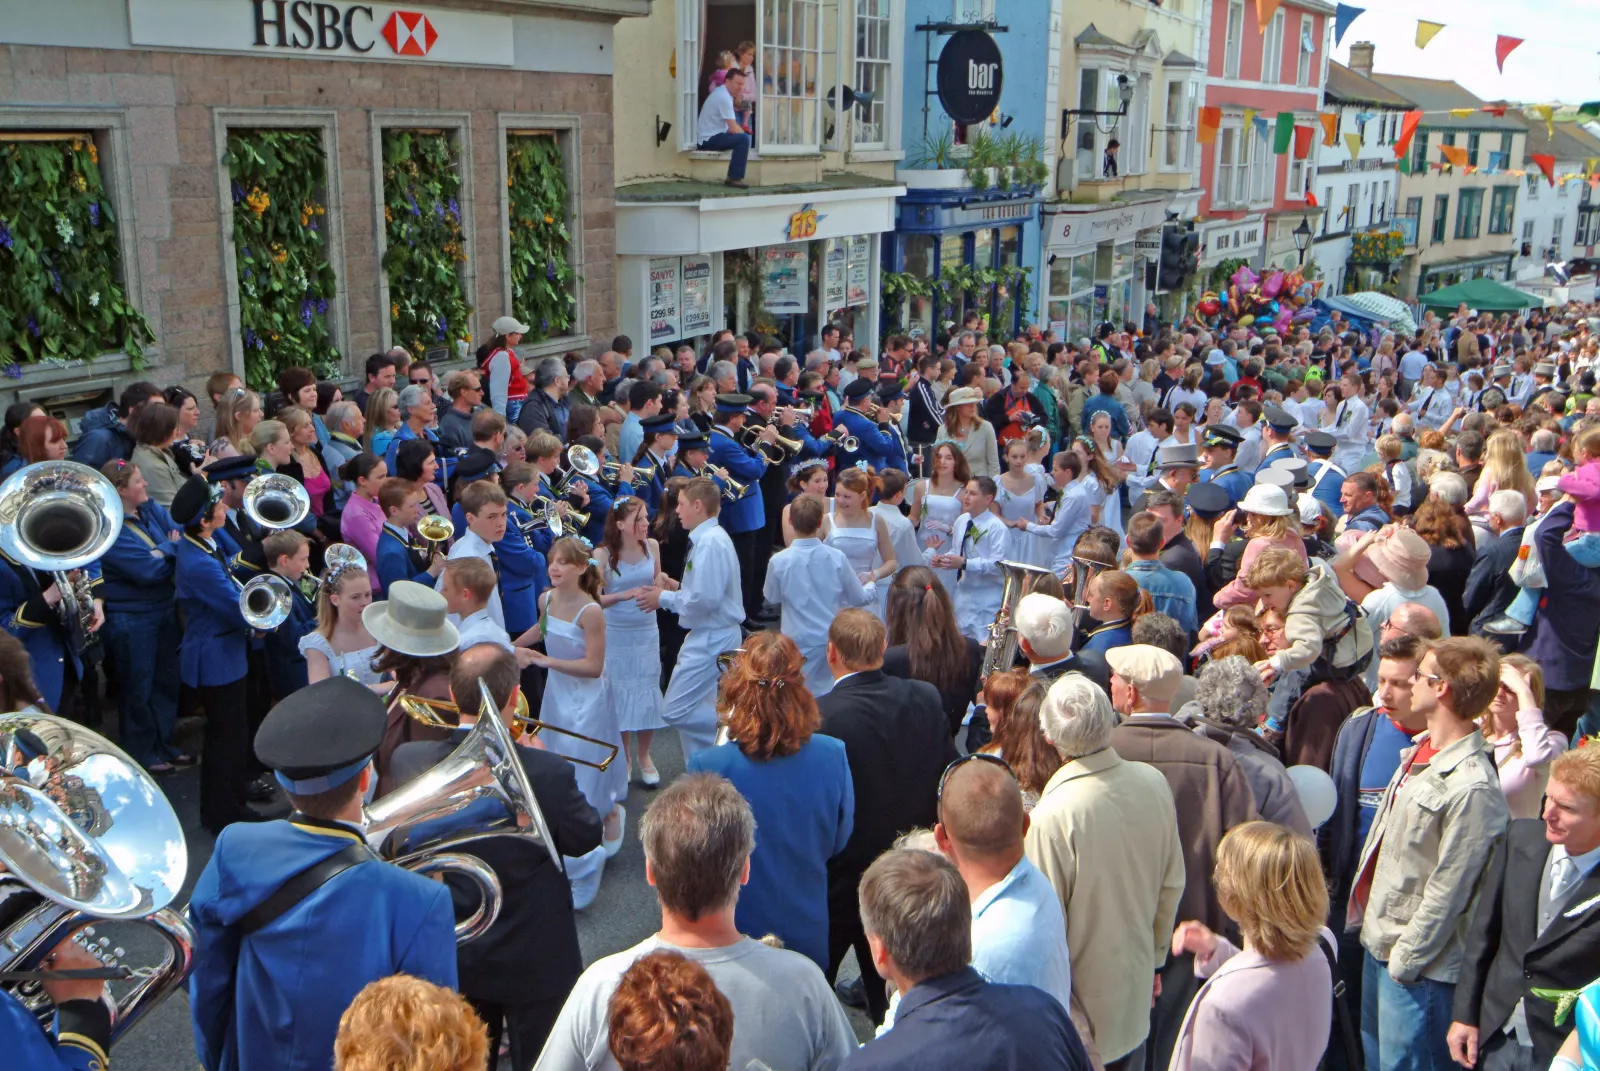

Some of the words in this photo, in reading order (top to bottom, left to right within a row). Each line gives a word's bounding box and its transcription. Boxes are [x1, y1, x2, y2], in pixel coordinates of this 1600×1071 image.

[252, 0, 376, 53] HSBC
[968, 58, 998, 89] bar
[1063, 224, 1071, 238] 8
[1243, 229, 1258, 244] LOOK
[650, 269, 675, 282] SANYO
[650, 307, 676, 320] £299.95
